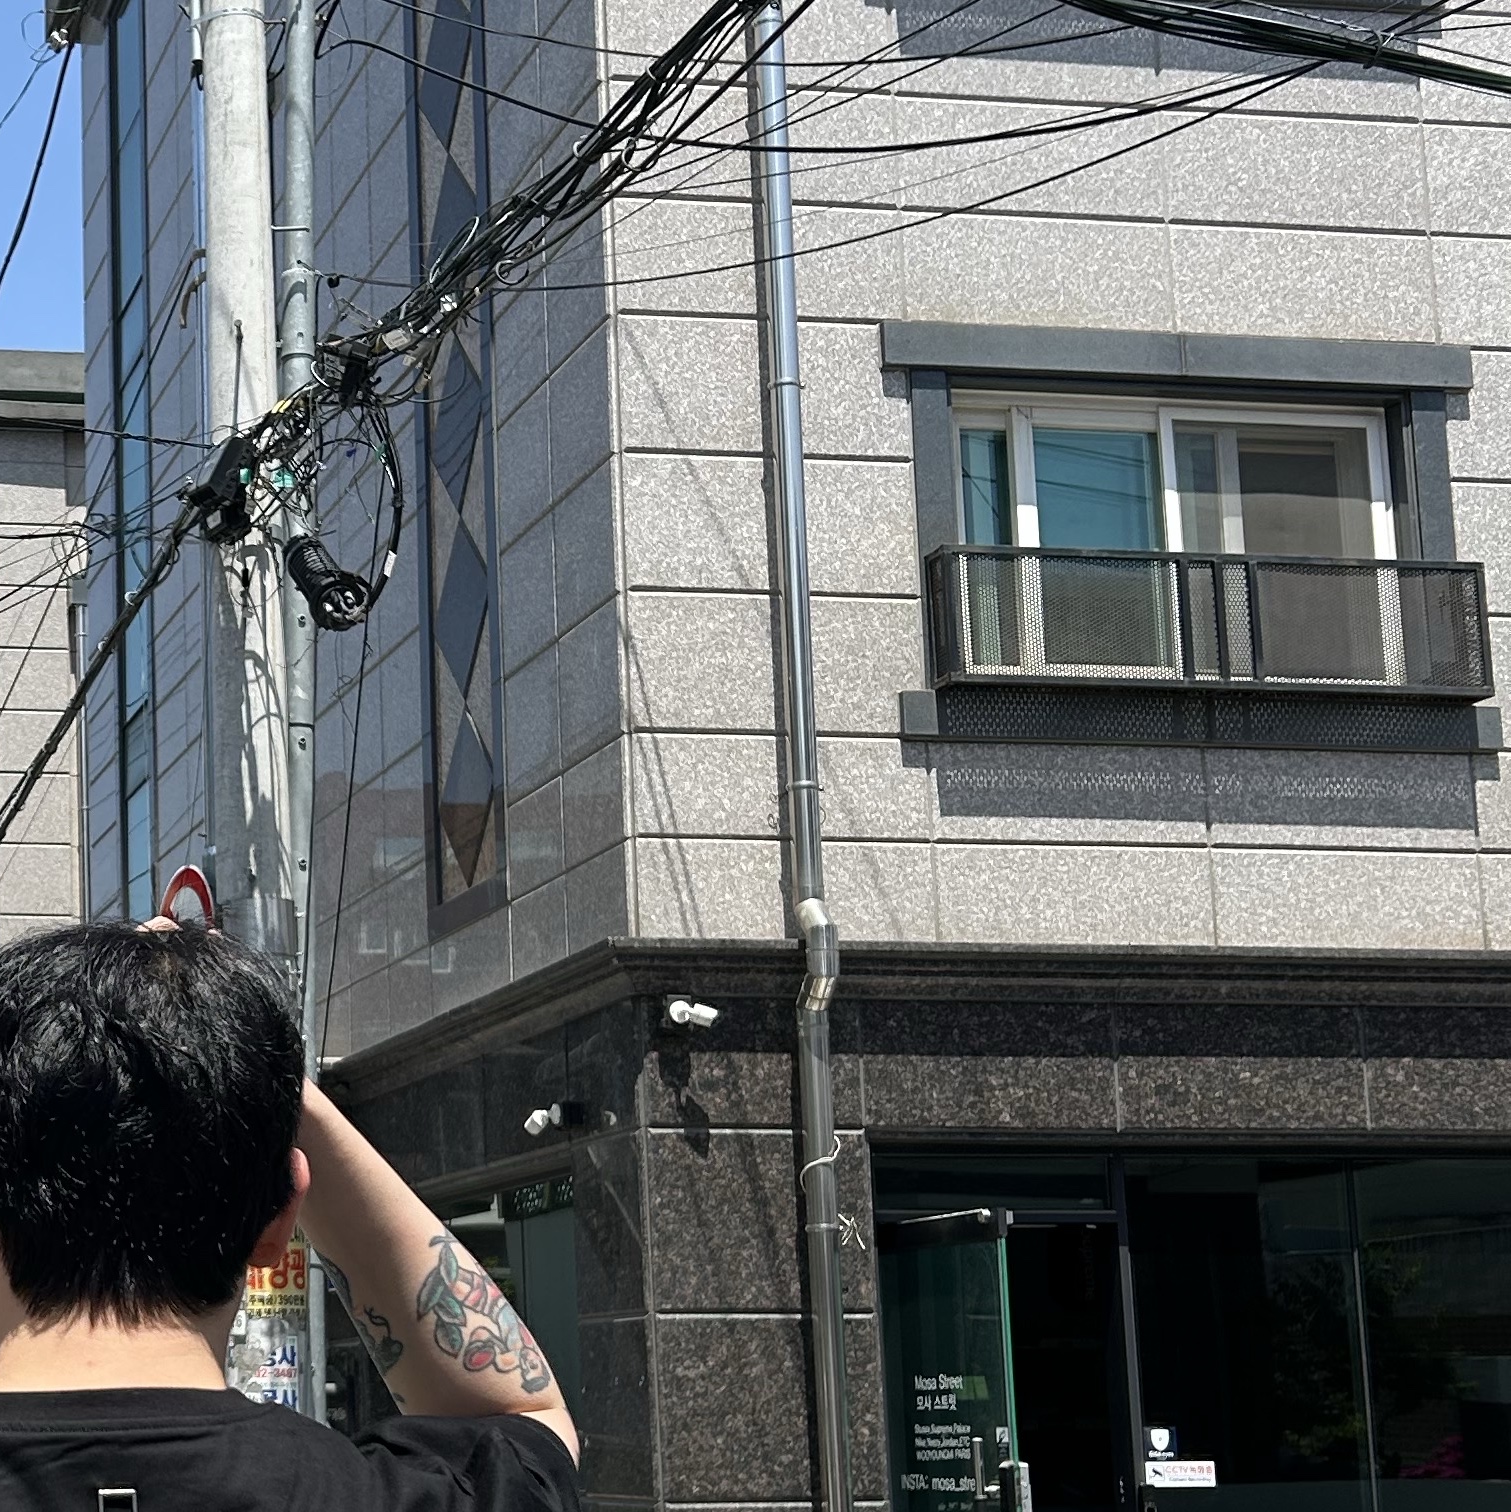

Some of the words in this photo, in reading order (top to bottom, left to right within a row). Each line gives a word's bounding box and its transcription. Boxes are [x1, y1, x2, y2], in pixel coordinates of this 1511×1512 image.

[914, 1374, 937, 1391] Mosa
[938, 1373, 963, 1390] Street
[916, 1393, 932, 1411] 모사
[900, 1473, 930, 1491] INSTA:
[931, 1475, 977, 1492] mosa_stre
